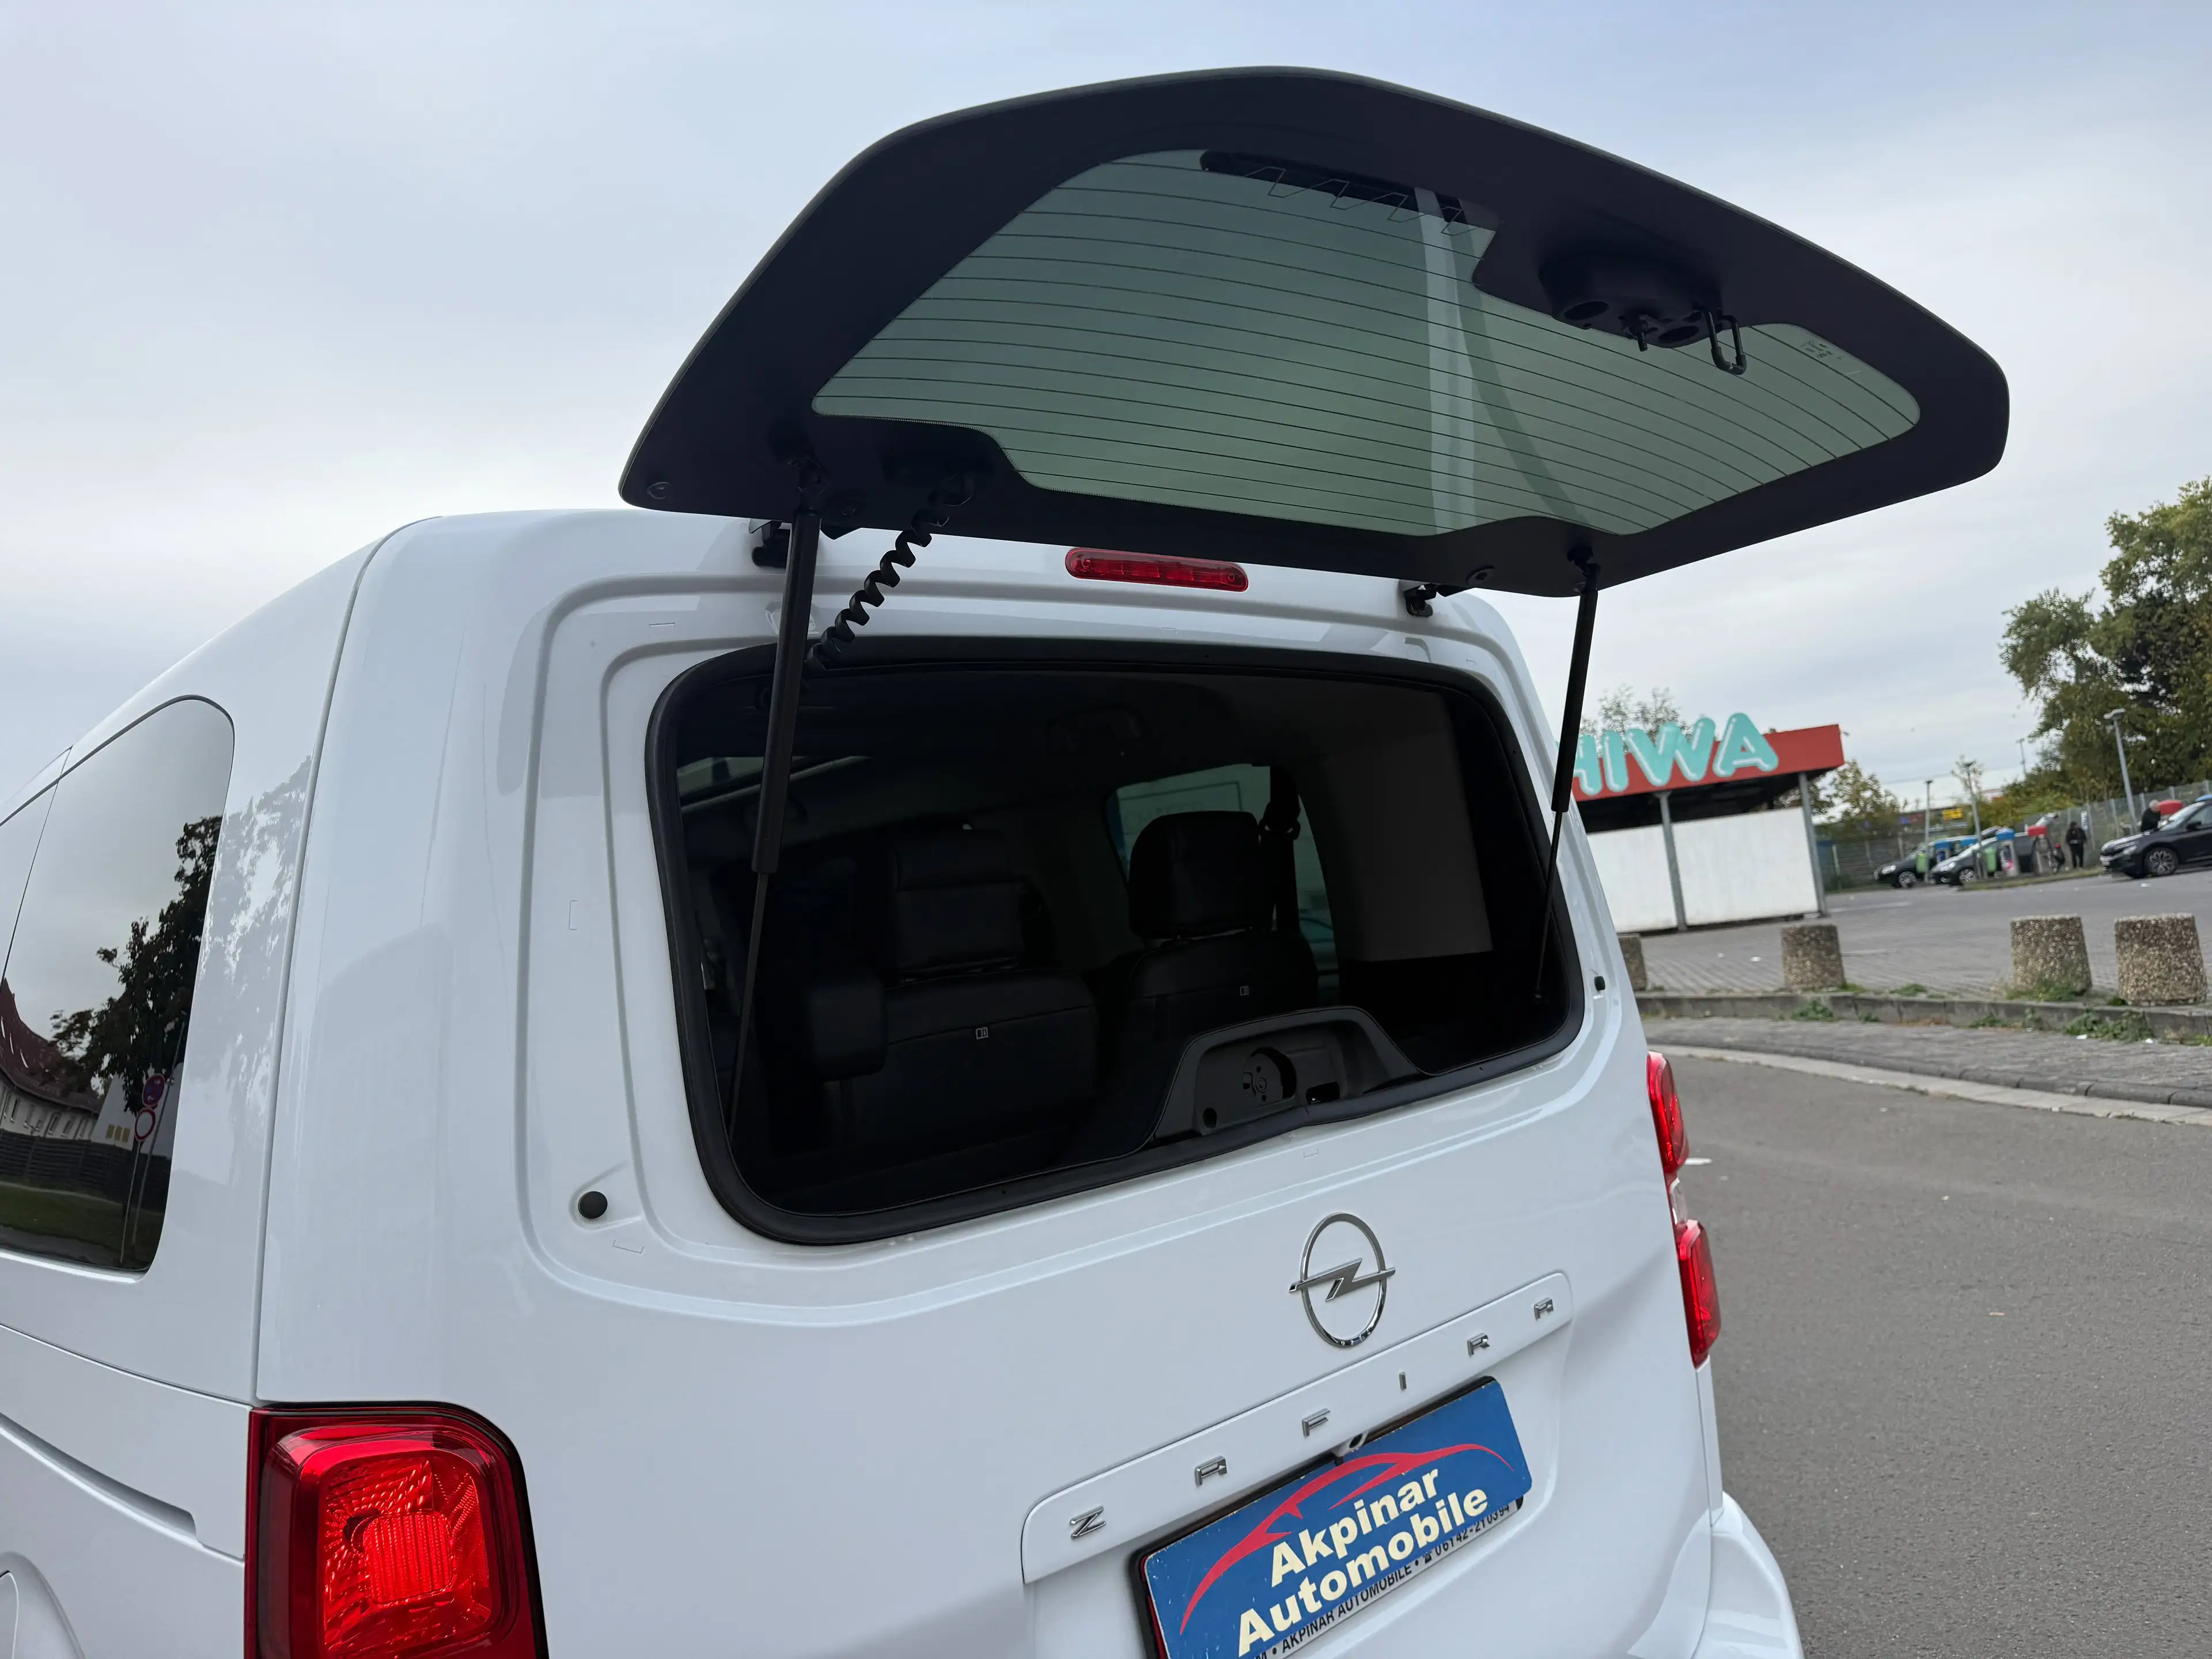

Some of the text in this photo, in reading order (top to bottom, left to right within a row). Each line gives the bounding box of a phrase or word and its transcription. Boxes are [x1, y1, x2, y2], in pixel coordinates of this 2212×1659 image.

[1070, 1297, 1554, 1539] ZAFIRA
[1238, 1488, 1488, 1658] Automobile
[1271, 1468, 1439, 1588] Akpinar
[1282, 1610, 1334, 1653] AKPINAR
[1338, 1565, 1412, 1618] AUTOMOBILE
